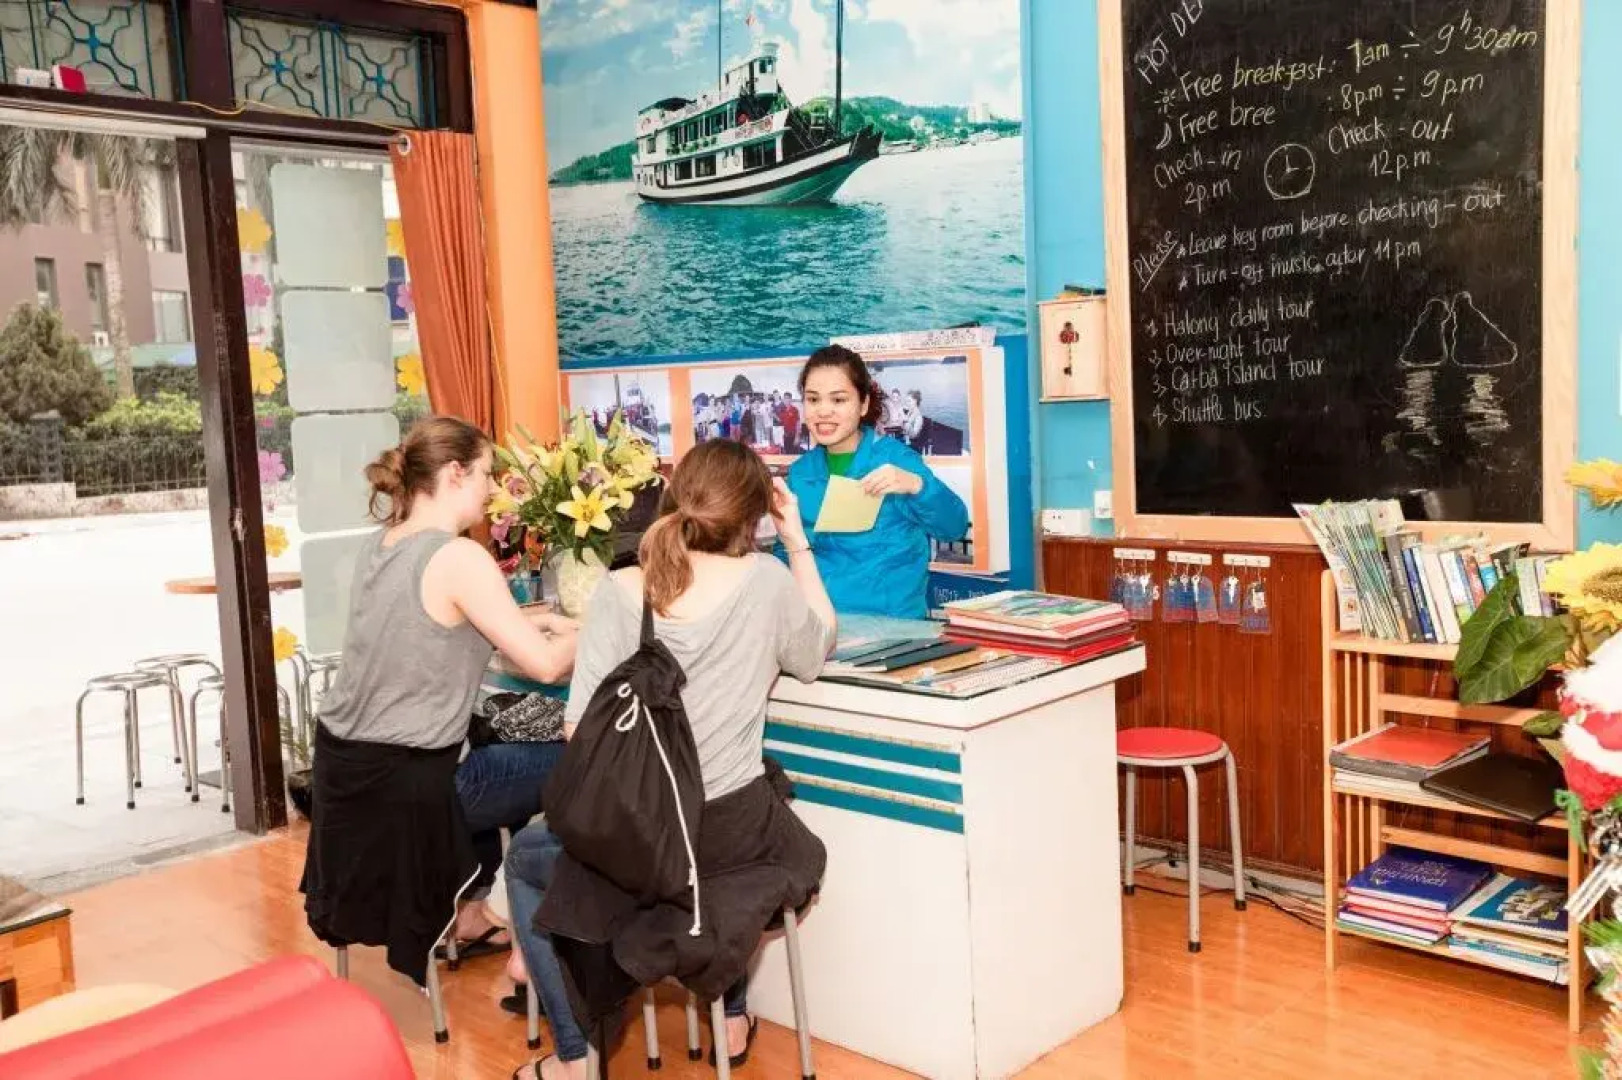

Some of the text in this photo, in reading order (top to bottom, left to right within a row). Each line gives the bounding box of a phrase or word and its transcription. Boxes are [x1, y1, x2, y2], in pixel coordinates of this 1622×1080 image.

[1137, 0, 1202, 85] HOT DE
[1180, 71, 1222, 101] Free
[1180, 112, 1219, 143] Free
[1230, 97, 1276, 126] bree
[1189, 231, 1227, 256] Leave
[1233, 224, 1257, 251] key
[1262, 222, 1293, 242] room
[1301, 210, 1349, 240] before
[1271, 252, 1317, 278] music
[1165, 309, 1218, 343] Halong
[1230, 297, 1269, 332] daily
[1278, 295, 1313, 321] tour
[1253, 330, 1292, 357] tour
[1286, 353, 1325, 381] tour
[1173, 394, 1225, 421] Shuttle
